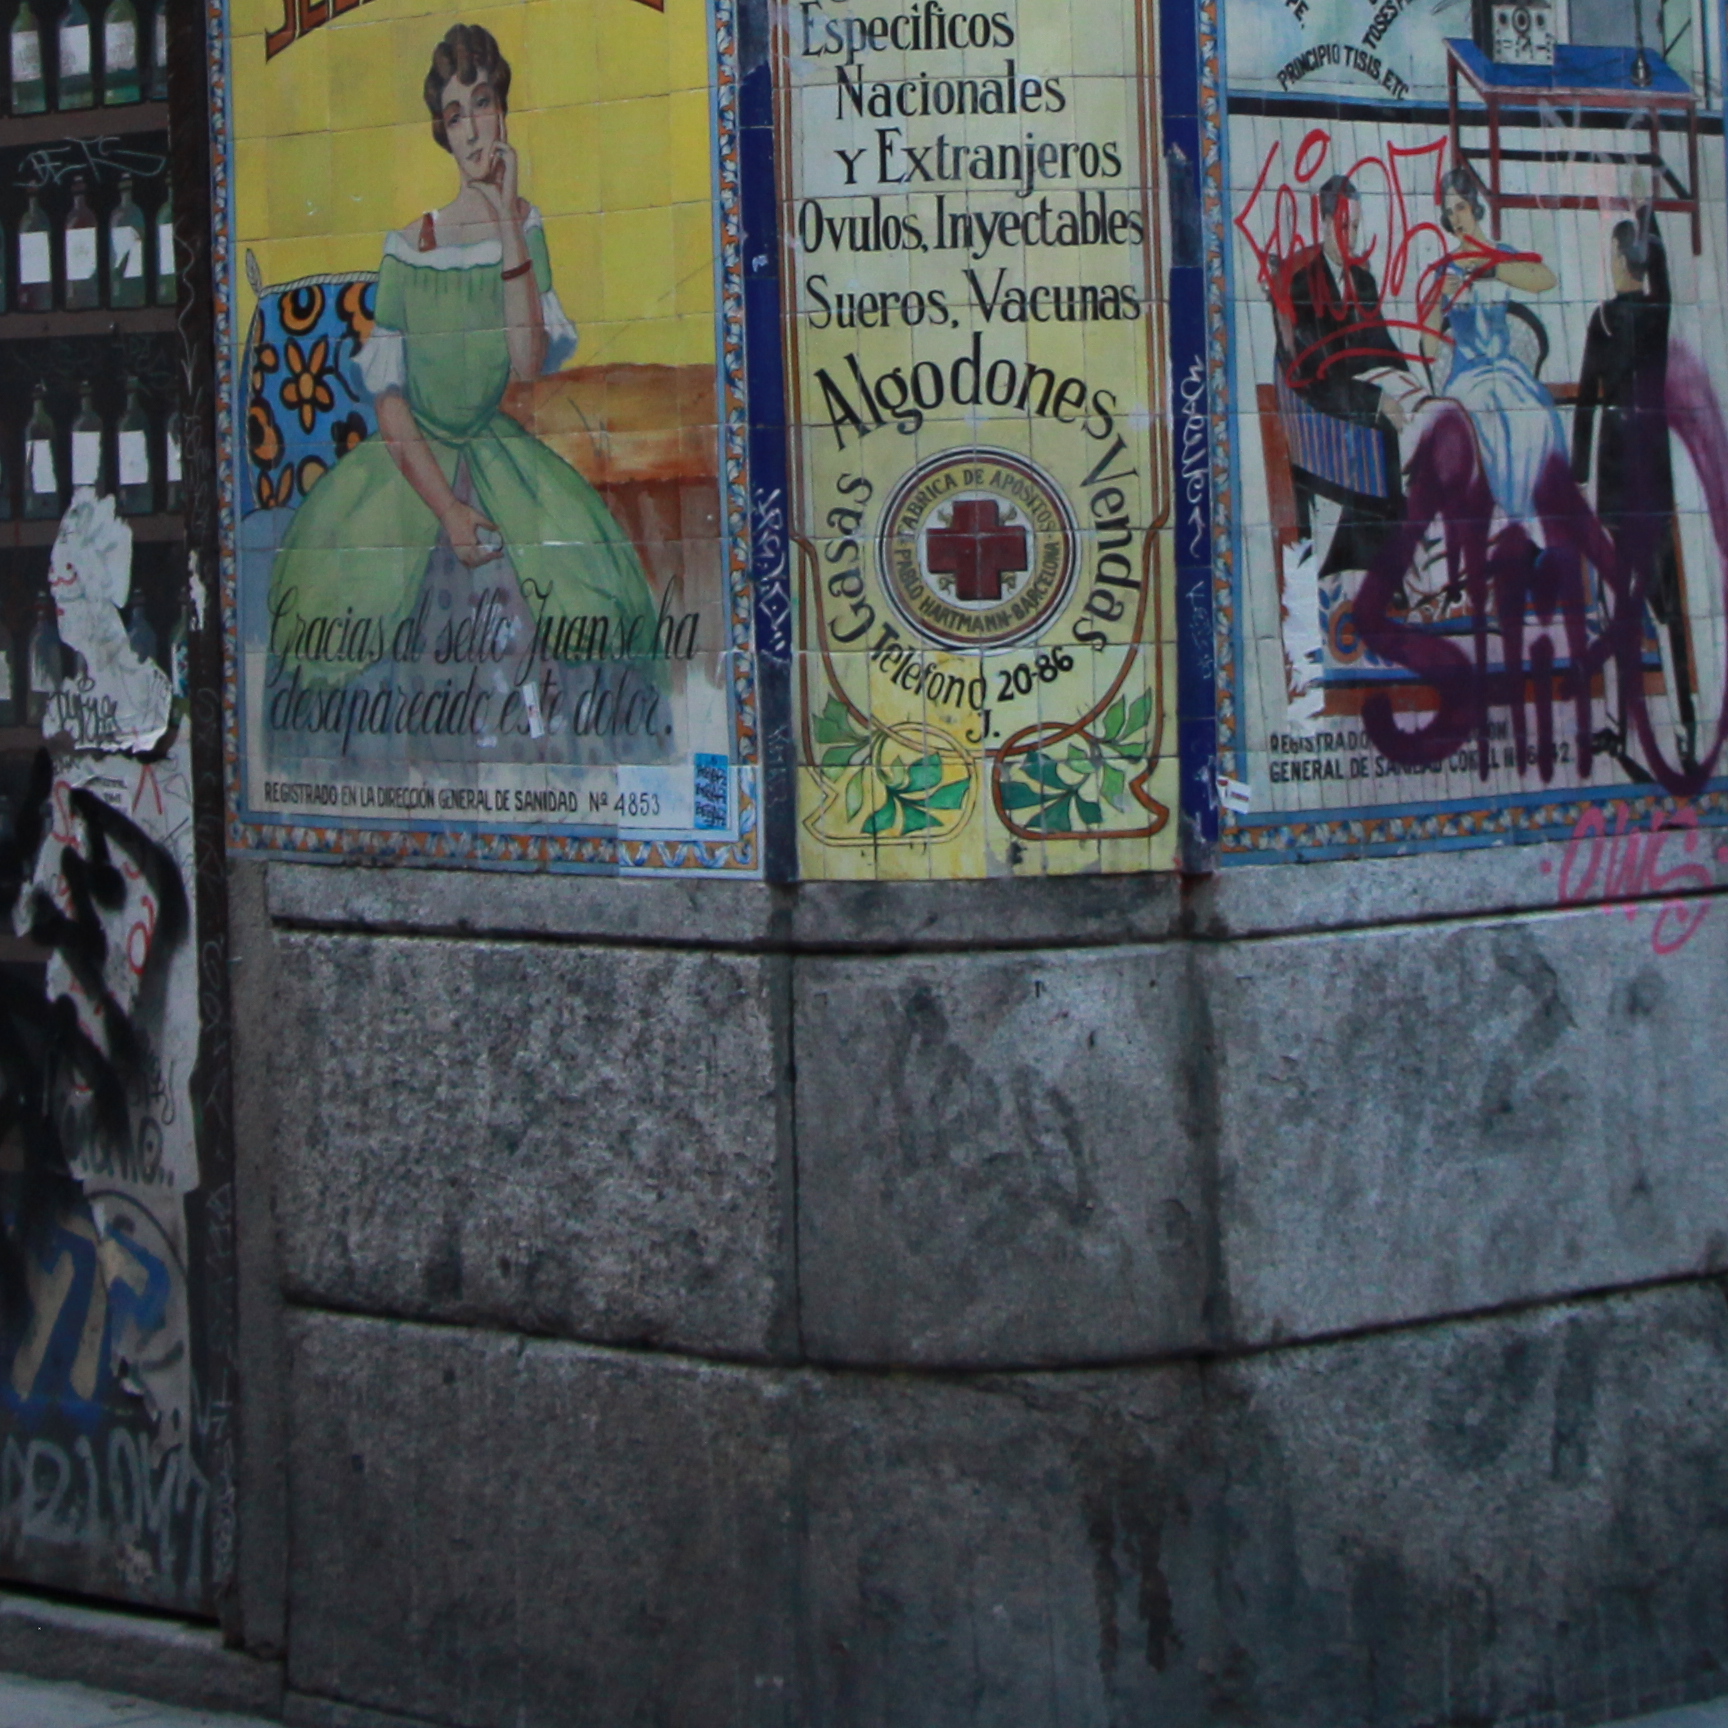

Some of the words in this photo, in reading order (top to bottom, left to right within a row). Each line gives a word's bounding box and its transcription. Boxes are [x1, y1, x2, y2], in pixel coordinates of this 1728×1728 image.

[1363, 0, 1399, 50] TOSES
[835, 58, 1067, 121] Nacionales
[1275, 43, 1340, 92] PRINCIPIO
[875, 128, 1123, 198] Extranjeros
[798, 198, 929, 254] Ovulos,
[933, 190, 1145, 259] Inyectables
[804, 274, 960, 330] Sueros,
[962, 267, 1141, 323] Vacunas
[813, 330, 1117, 452] Algodones
[963, 469, 986, 486] DE
[826, 473, 876, 644] Gasas
[1072, 433, 1142, 653] Vendas
[267, 584, 384, 687] Gracias
[392, 588, 422, 663] al
[435, 586, 511, 664] sello
[651, 572, 700, 662] ha
[997, 647, 1074, 702] 20-86
[270, 664, 492, 756] desaparecido
[264, 781, 337, 806] REGISTRADO
[341, 784, 358, 807] EN
[359, 784, 376, 808] LA
[438, 788, 493, 811] GENERAL
[494, 789, 511, 811] DE
[514, 789, 578, 813] SANIDAD
[614, 792, 661, 817] 4853
[1271, 758, 1344, 784] GENERAL
[1350, 756, 1371, 779] DE
